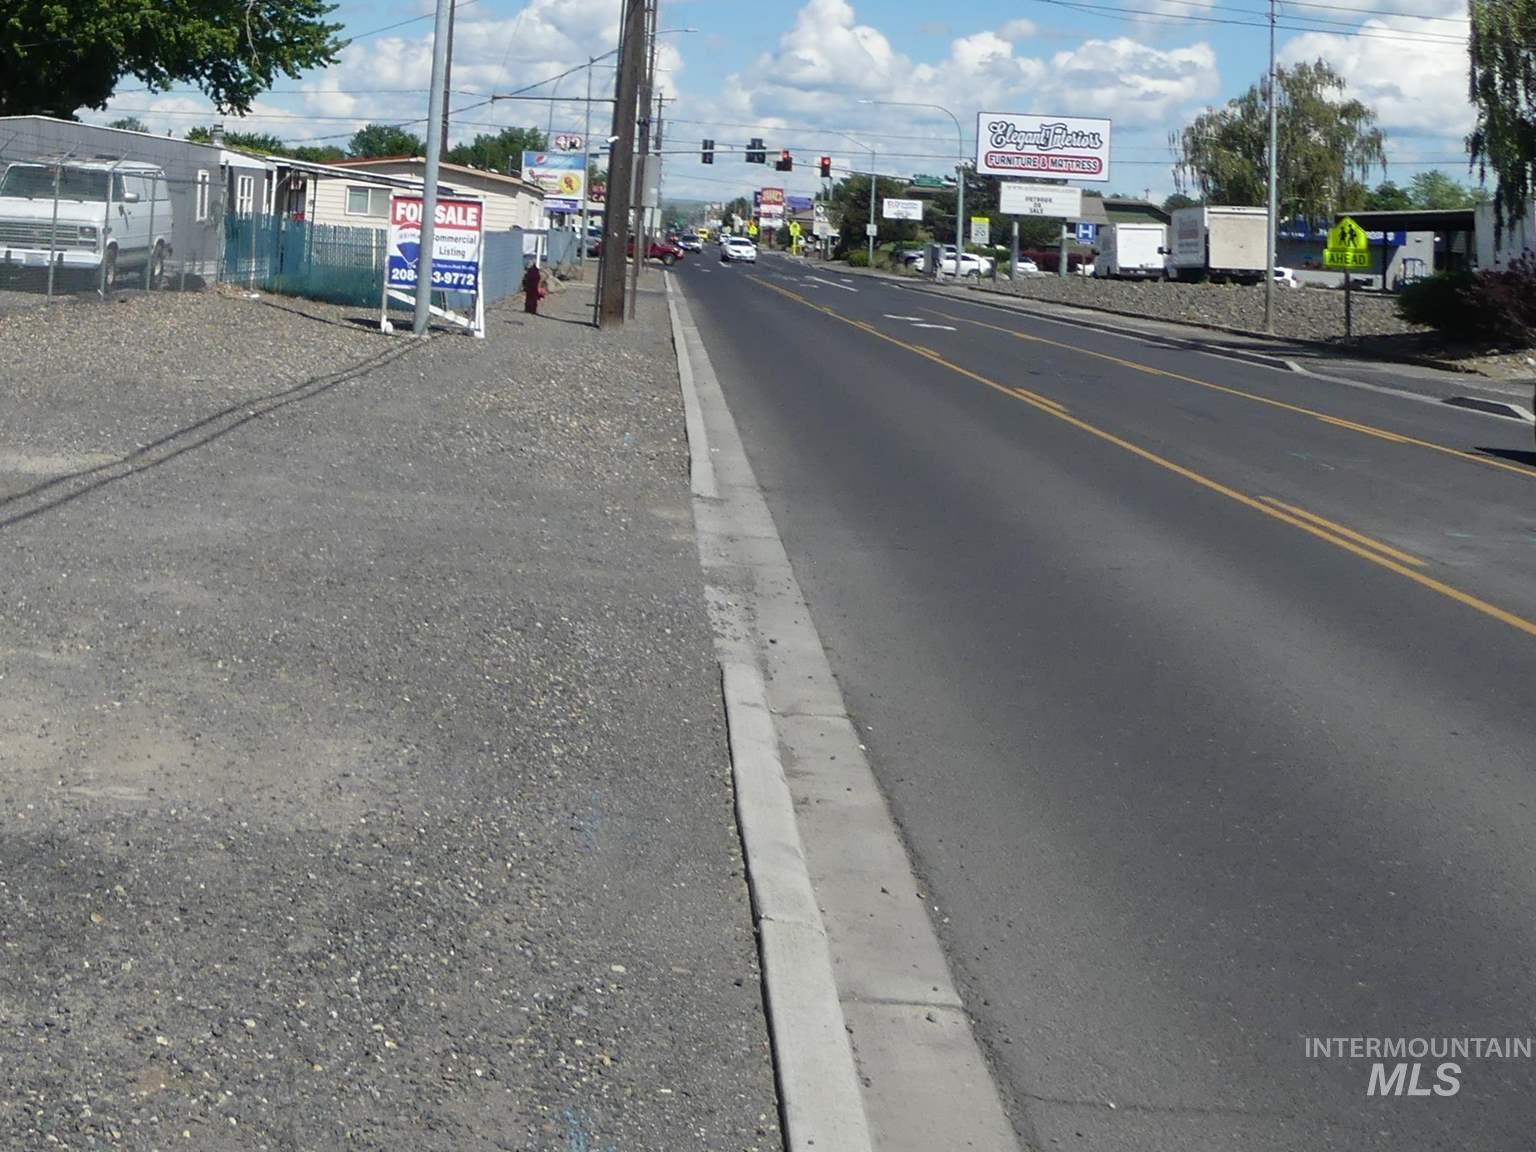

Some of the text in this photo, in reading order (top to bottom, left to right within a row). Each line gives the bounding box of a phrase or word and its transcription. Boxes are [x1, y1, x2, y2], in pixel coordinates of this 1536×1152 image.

[988, 120, 1103, 152] Elegant Interiors
[989, 154, 1099, 171] FURNITURE & MATTRESS
[396, 202, 479, 226] FO SALE
[1078, 226, 1093, 239] H
[439, 246, 466, 259] Listing
[1328, 252, 1367, 266] AHEAD
[391, 267, 475, 286] 208-3-9772
